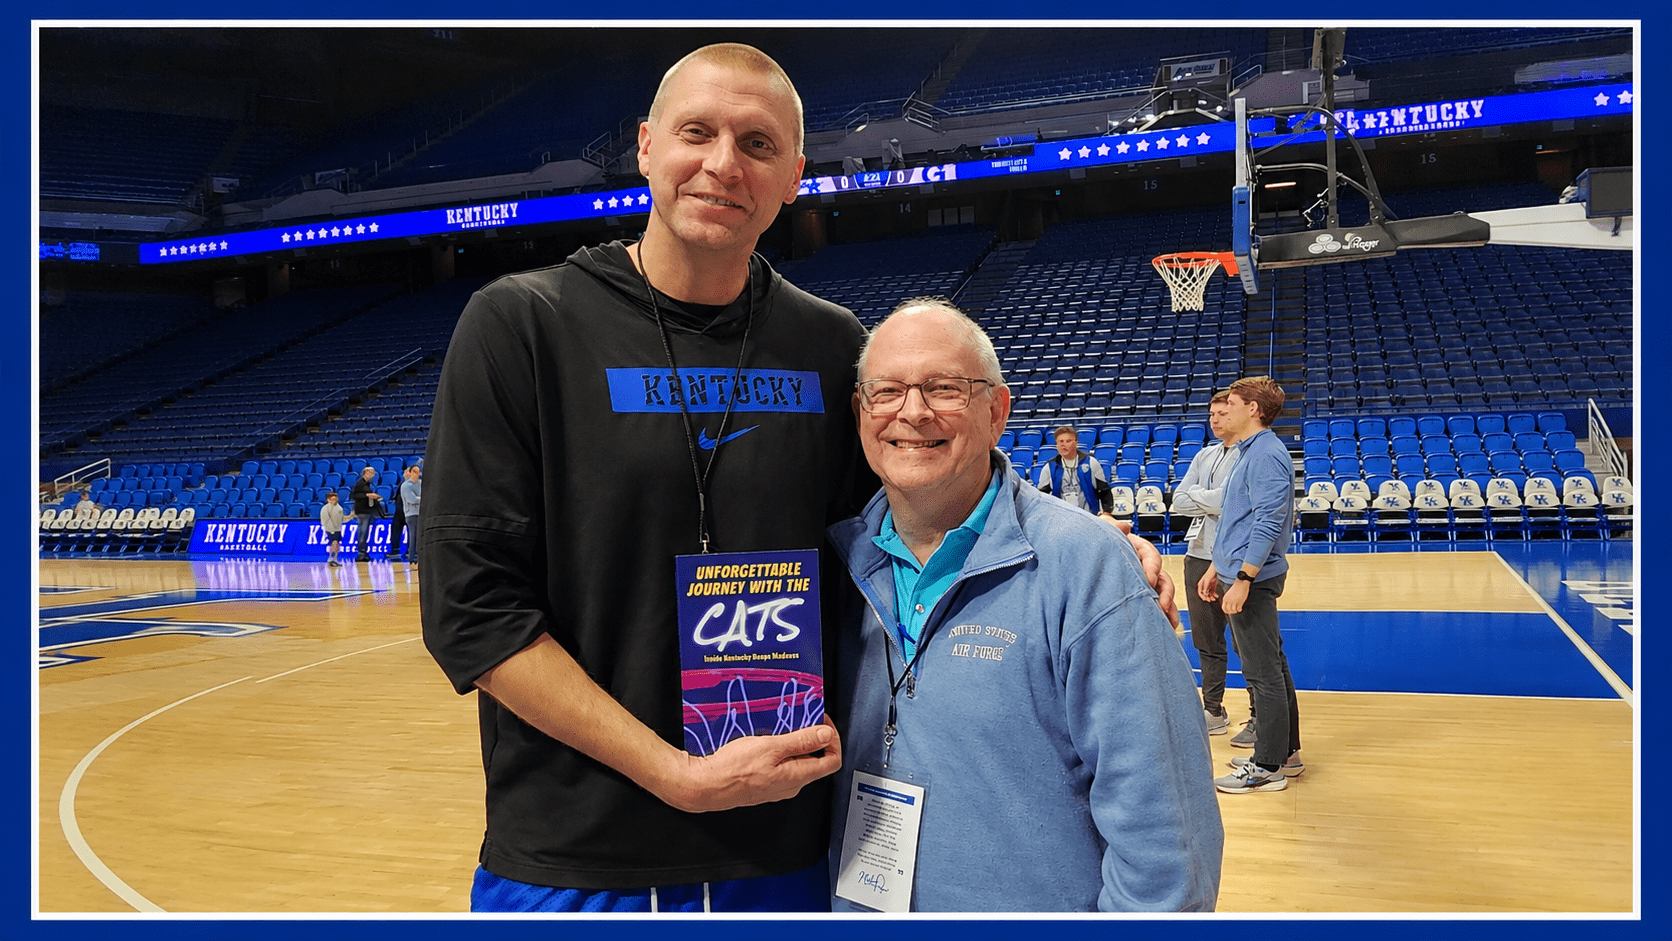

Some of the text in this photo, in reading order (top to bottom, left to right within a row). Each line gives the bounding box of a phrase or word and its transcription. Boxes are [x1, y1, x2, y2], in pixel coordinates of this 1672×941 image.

[446, 202, 519, 224] KENTUCKY
[641, 374, 803, 406] KENTUCKY
[204, 523, 288, 543] KENTUCKY
[696, 562, 802, 580] UNFORGETTABLE
[686, 578, 811, 597] JOURNEY WITH THE
[693, 597, 805, 652] CATS
[951, 643, 971, 657] AIR
